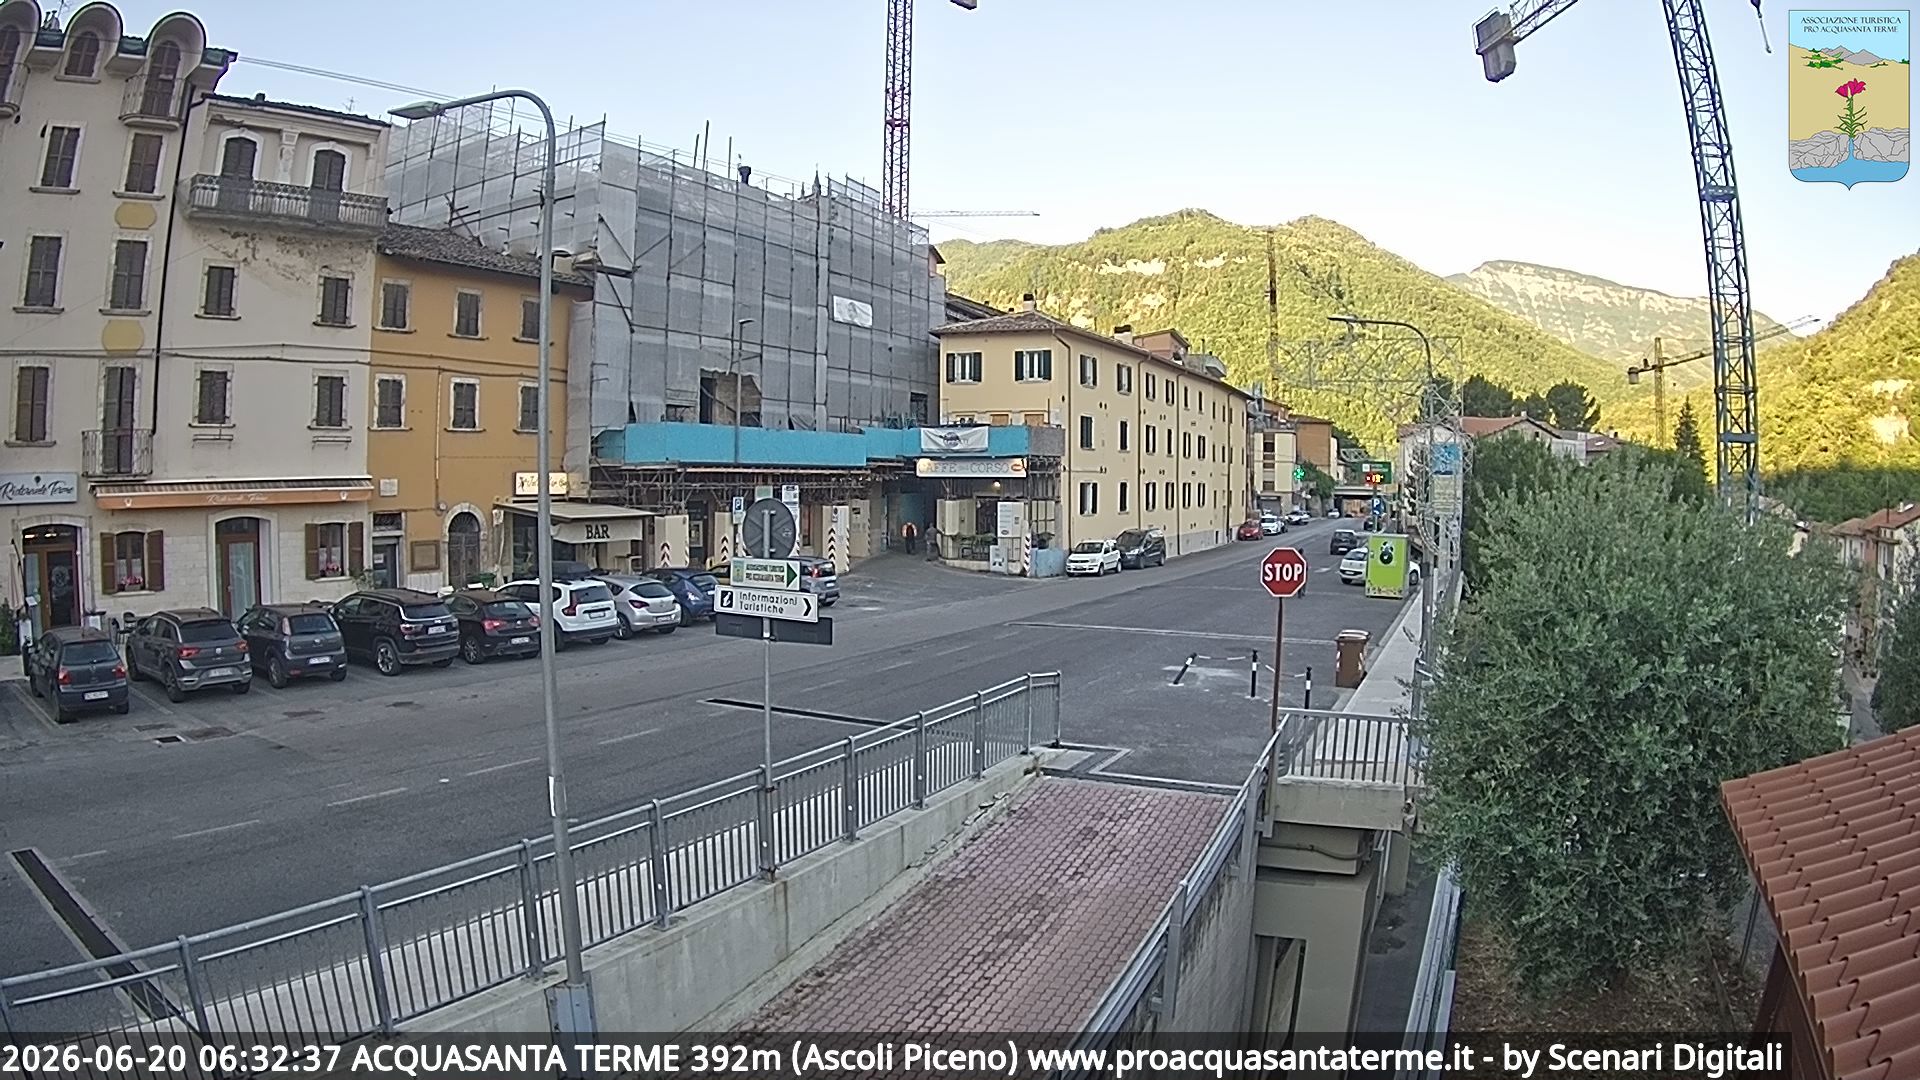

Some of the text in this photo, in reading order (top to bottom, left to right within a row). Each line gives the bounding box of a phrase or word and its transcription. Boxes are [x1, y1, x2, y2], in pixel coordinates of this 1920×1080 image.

[969, 462, 1010, 474] CORSO
[1373, 499, 1380, 507] P
[585, 524, 610, 539] BAR
[1264, 563, 1303, 582] STOP
[740, 591, 798, 605] Informazioni
[740, 601, 784, 614] Turistiche
